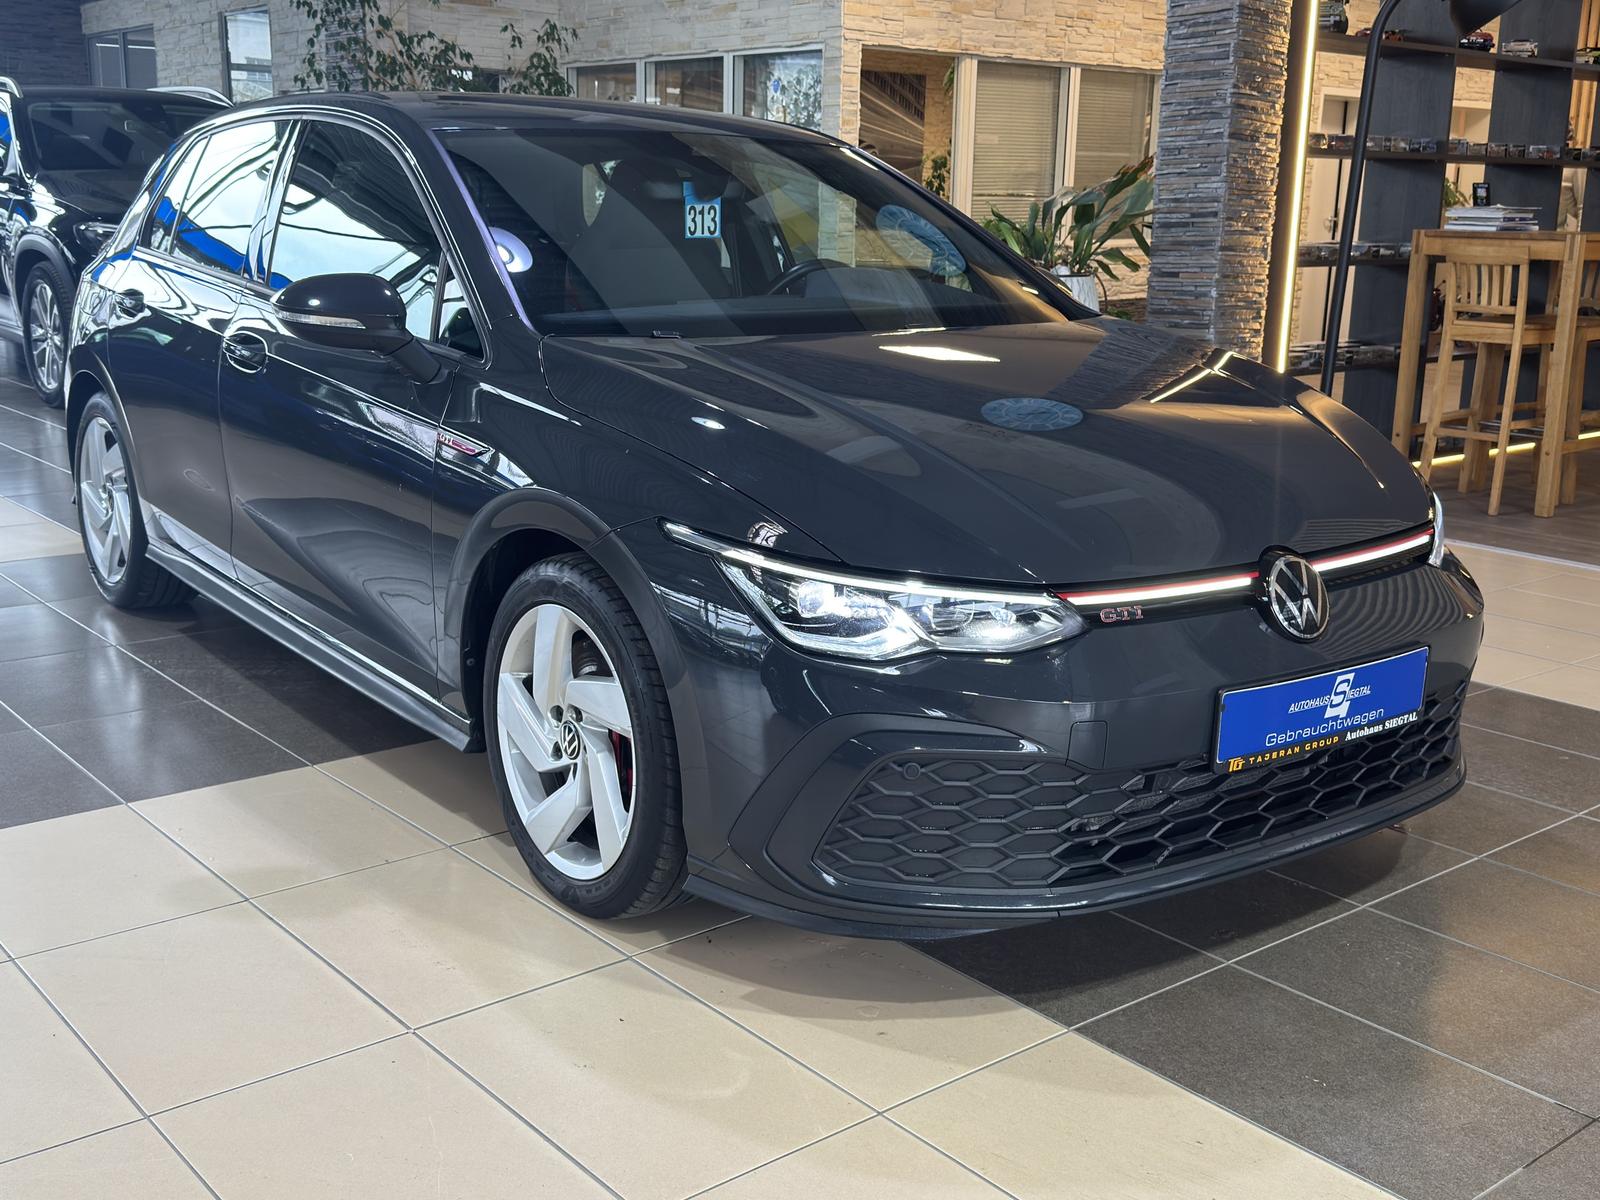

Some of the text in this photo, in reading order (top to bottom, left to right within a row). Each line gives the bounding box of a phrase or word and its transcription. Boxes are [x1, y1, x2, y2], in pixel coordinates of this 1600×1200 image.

[688, 205, 718, 235] 313
[1100, 605, 1144, 623] GTI
[1288, 695, 1331, 713] AUTOHAUS
[1265, 708, 1384, 747] Gebrauchtwagen
[1345, 712, 1418, 741] Autohaus SIEGTAL
[1249, 746, 1300, 765] TAJERAN
[1305, 736, 1339, 751] GROUP
